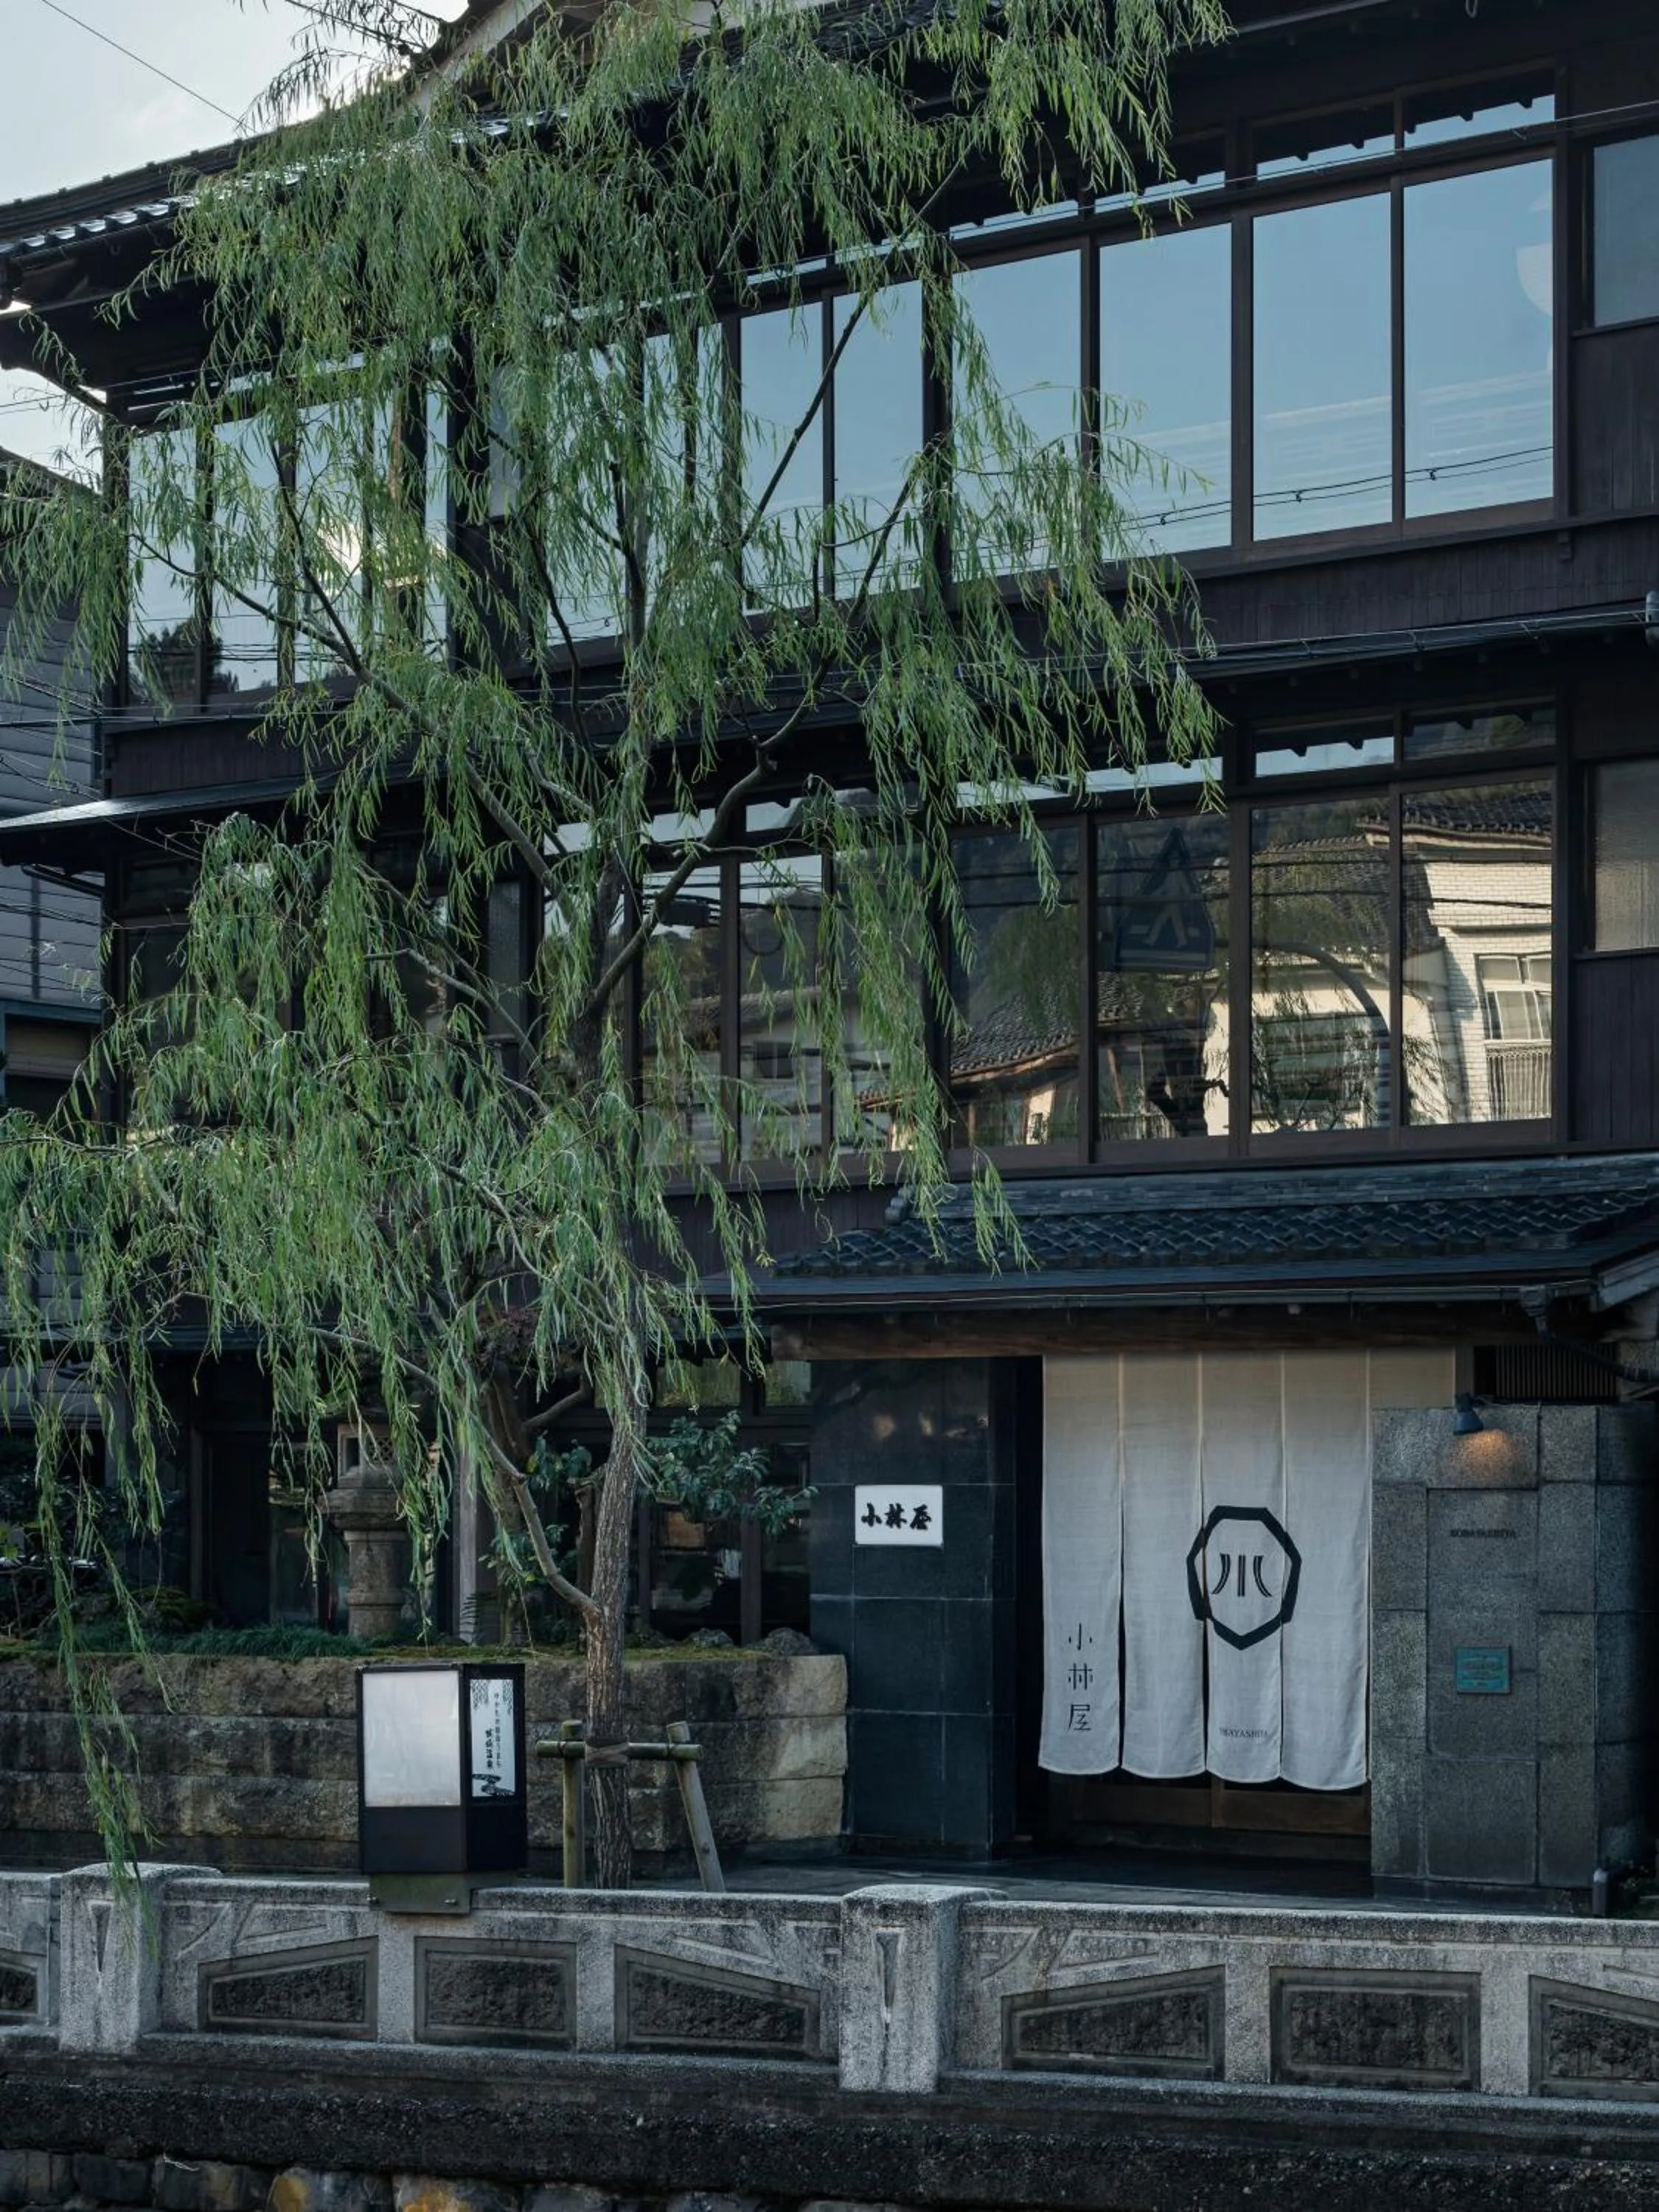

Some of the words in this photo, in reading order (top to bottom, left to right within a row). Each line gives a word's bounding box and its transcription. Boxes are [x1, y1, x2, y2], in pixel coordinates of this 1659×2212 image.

[860, 1503, 932, 1531] 小林屋
[1068, 1623, 1093, 1731] 小林屋
